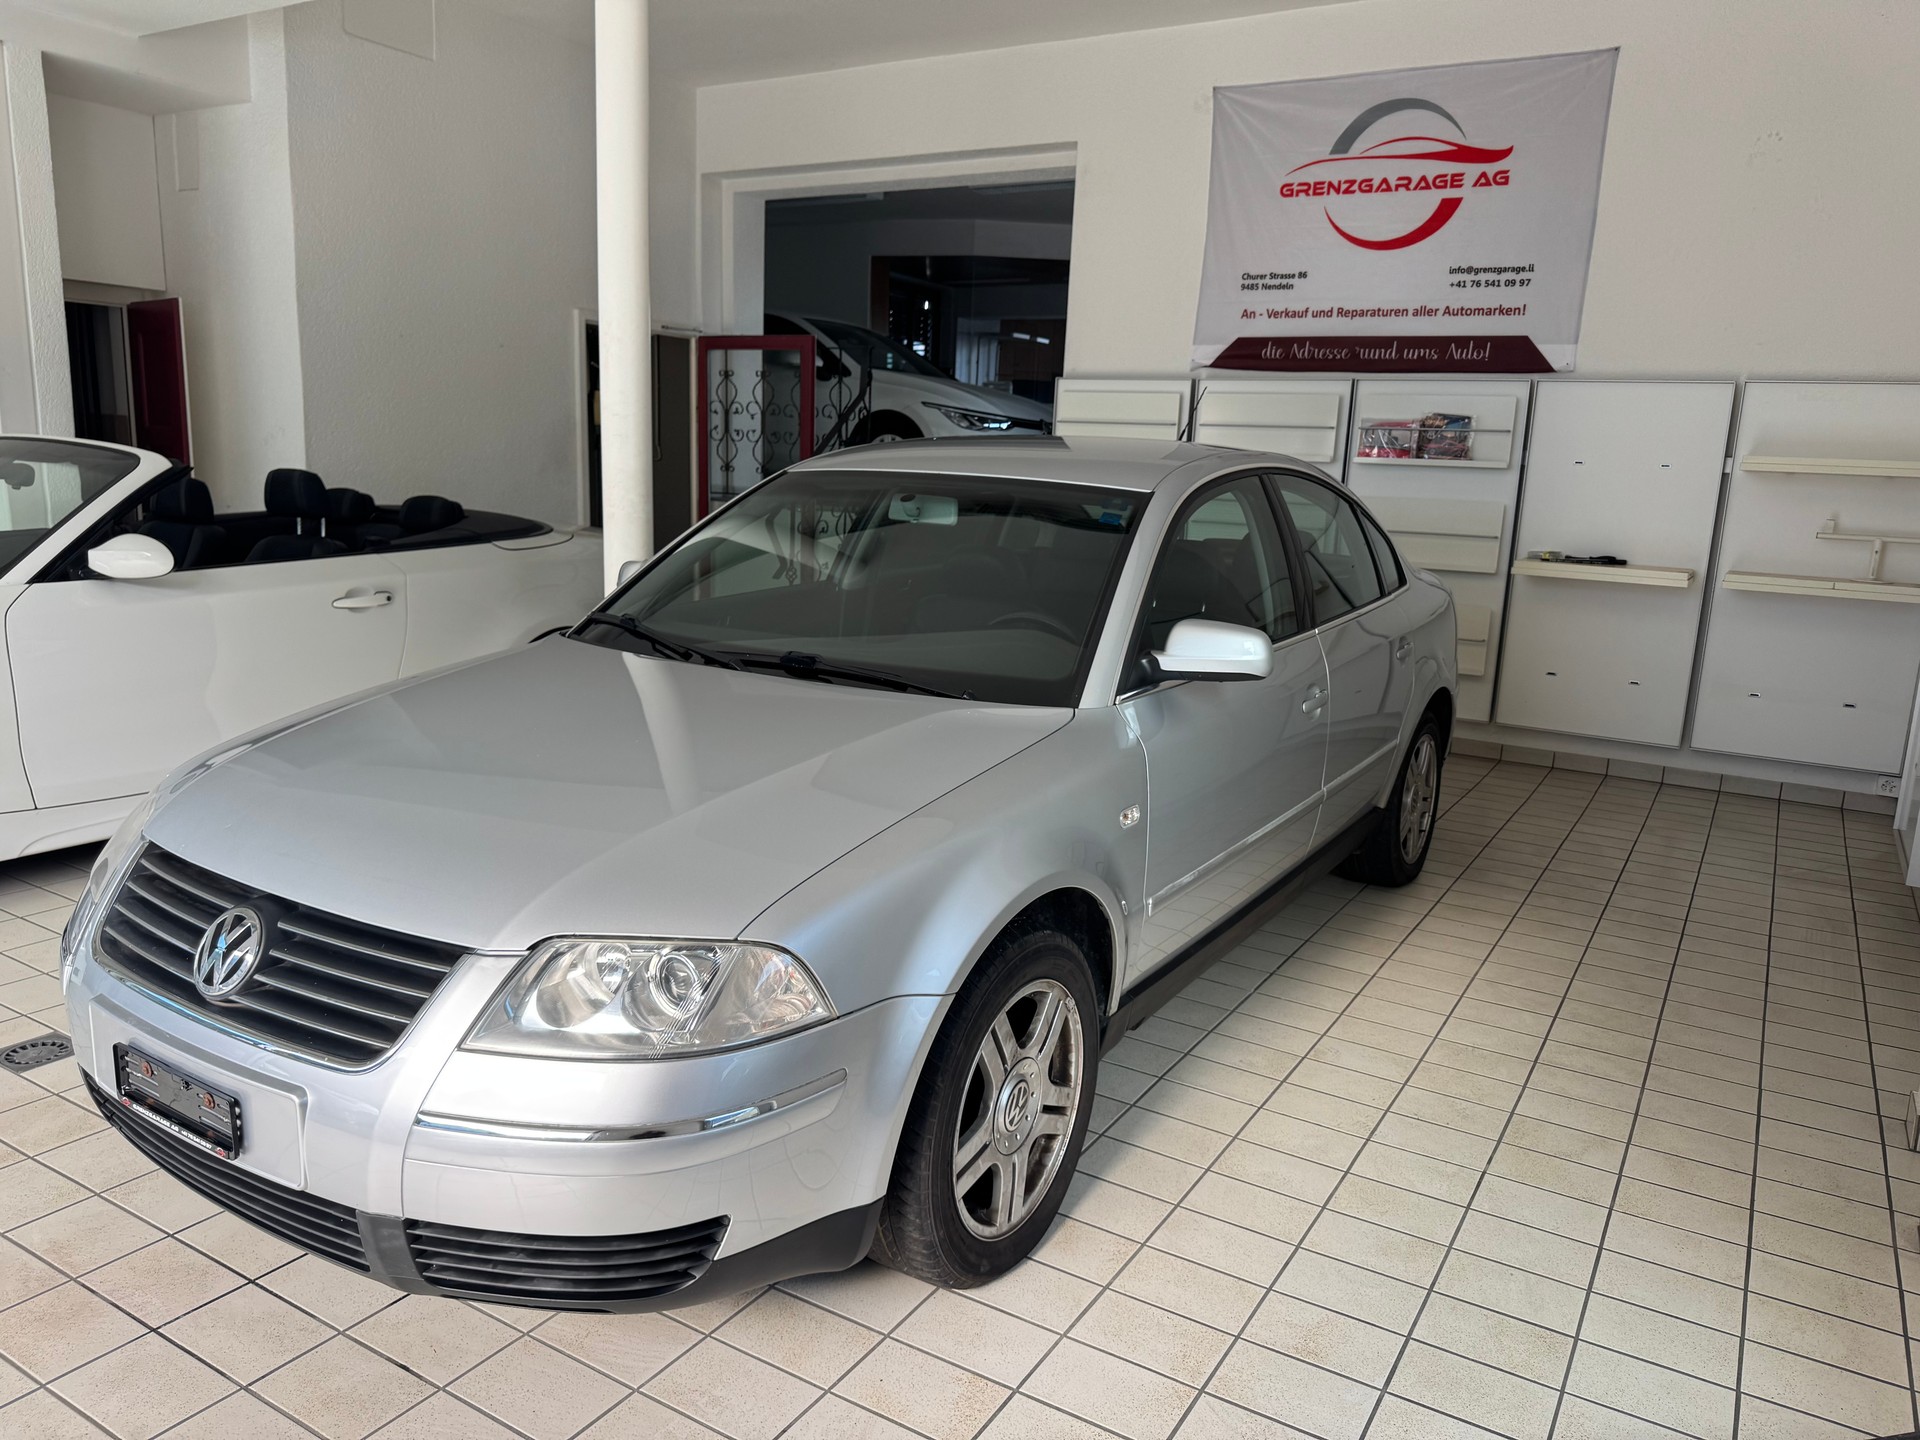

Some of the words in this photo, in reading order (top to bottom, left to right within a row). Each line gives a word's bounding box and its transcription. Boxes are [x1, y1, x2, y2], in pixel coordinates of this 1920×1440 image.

[1279, 172, 1465, 197] GRENZGARAGE
[1472, 169, 1510, 187] AG
[1449, 263, 1534, 275] info@grenzgarage.li
[1241, 273, 1267, 281] Churer
[1268, 272, 1296, 280] Strasse
[1297, 271, 1308, 279] 86
[1240, 283, 1259, 291] 9485
[1261, 282, 1294, 290] Nendeln
[1449, 280, 1467, 288] +41
[1470, 280, 1482, 288] 76
[1484, 279, 1501, 287] 541
[1504, 279, 1516, 287] 09
[1519, 278, 1531, 286] 97
[1240, 309, 1256, 319] An
[1266, 308, 1310, 319] Verkauf
[1311, 307, 1333, 318] und
[1336, 306, 1409, 320] Reparaturen
[1412, 305, 1440, 317] aller
[1442, 303, 1527, 316] Automarken!
[1261, 341, 1285, 359] die
[1288, 341, 1350, 360] Adresse
[1355, 340, 1400, 360] rund
[1403, 346, 1439, 360] ums
[1445, 341, 1491, 361] Auto!
